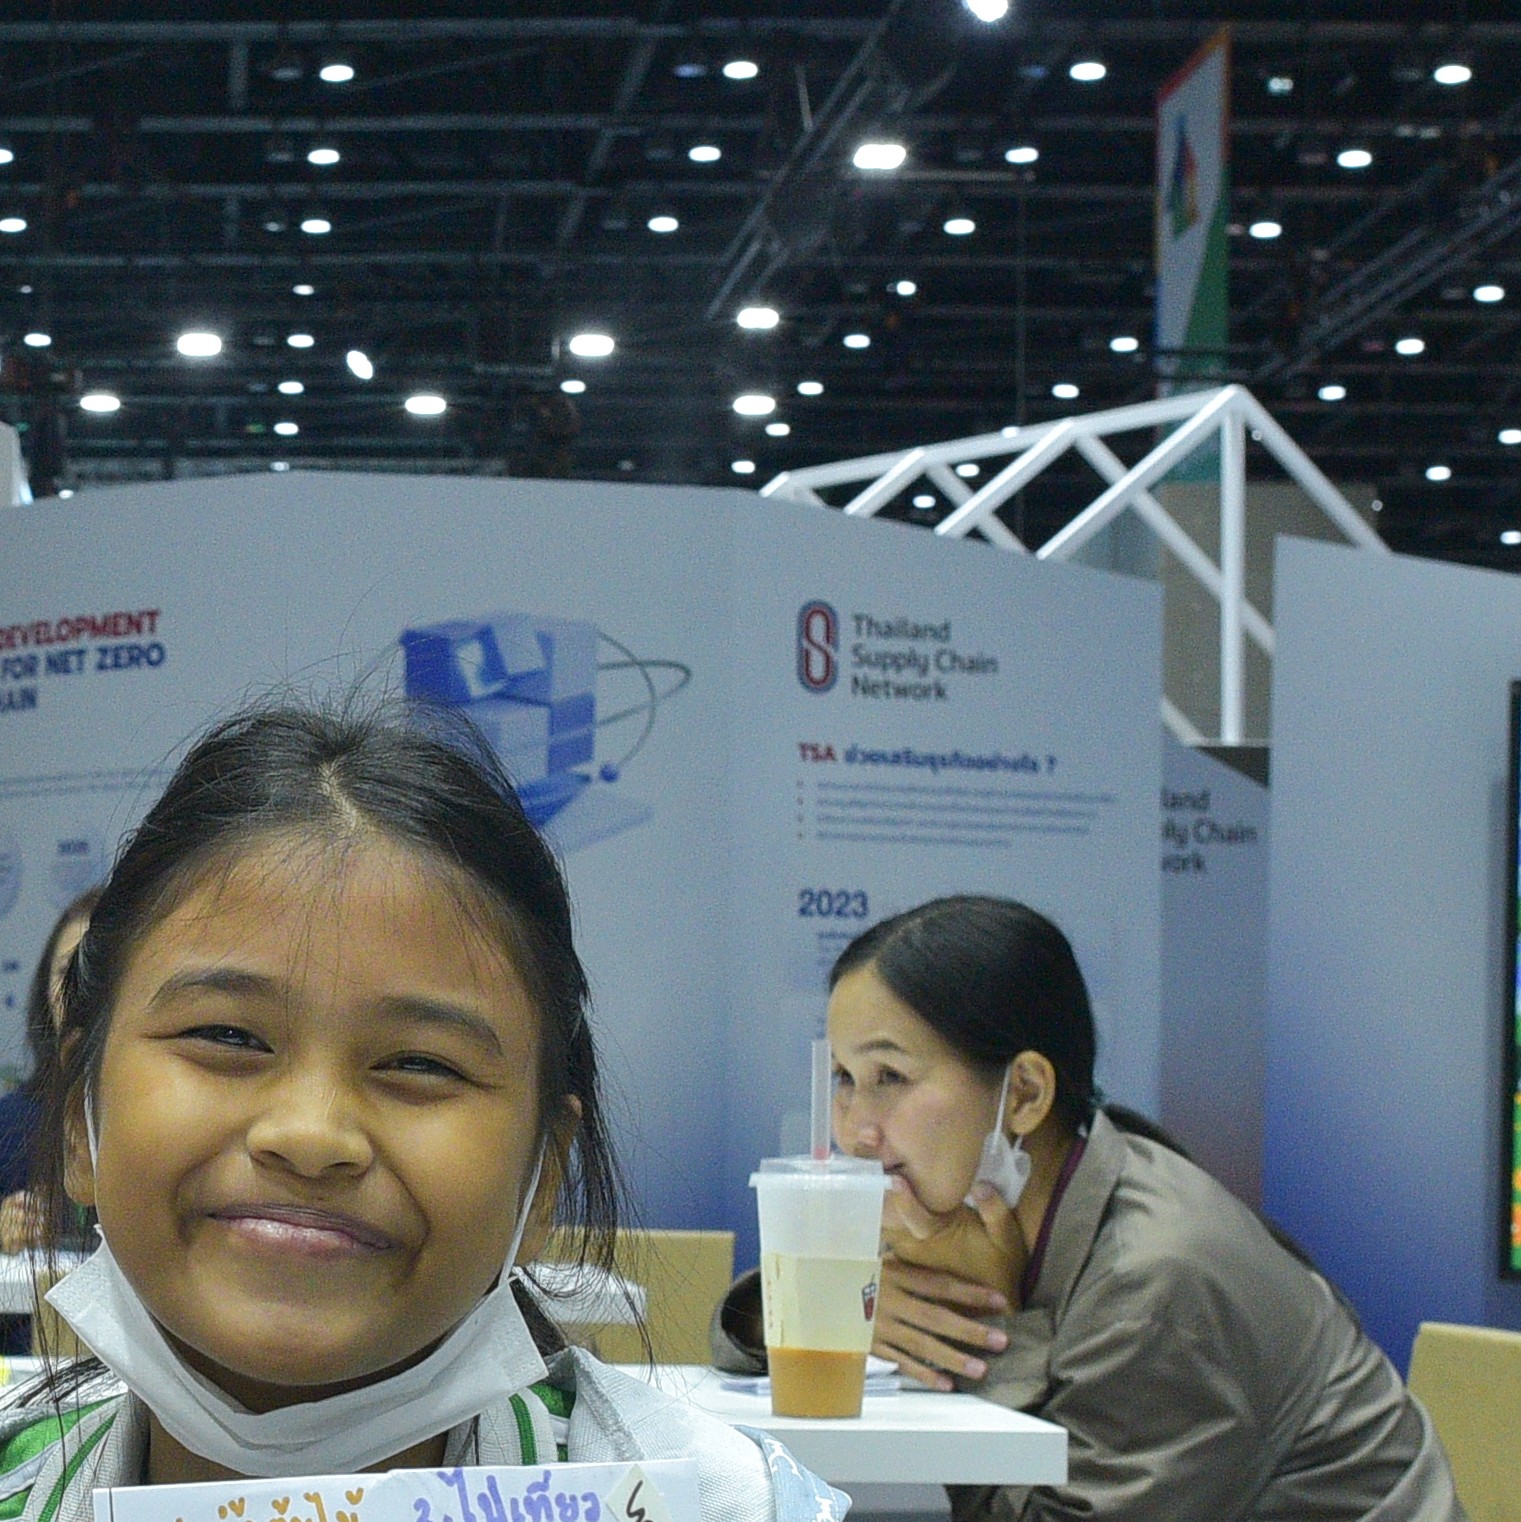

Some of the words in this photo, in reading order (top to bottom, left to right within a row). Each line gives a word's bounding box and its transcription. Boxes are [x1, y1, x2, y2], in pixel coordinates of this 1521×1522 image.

[851, 612, 952, 642] Thailand
[1, 652, 39, 681] FOR
[44, 647, 88, 677] NET
[95, 642, 167, 673] ZERO
[851, 643, 930, 678] Supply
[934, 647, 999, 675] Chain
[850, 675, 947, 701] Network
[797, 741, 837, 763] TSA
[1192, 817, 1258, 844] Chain
[797, 888, 869, 919] 2023
